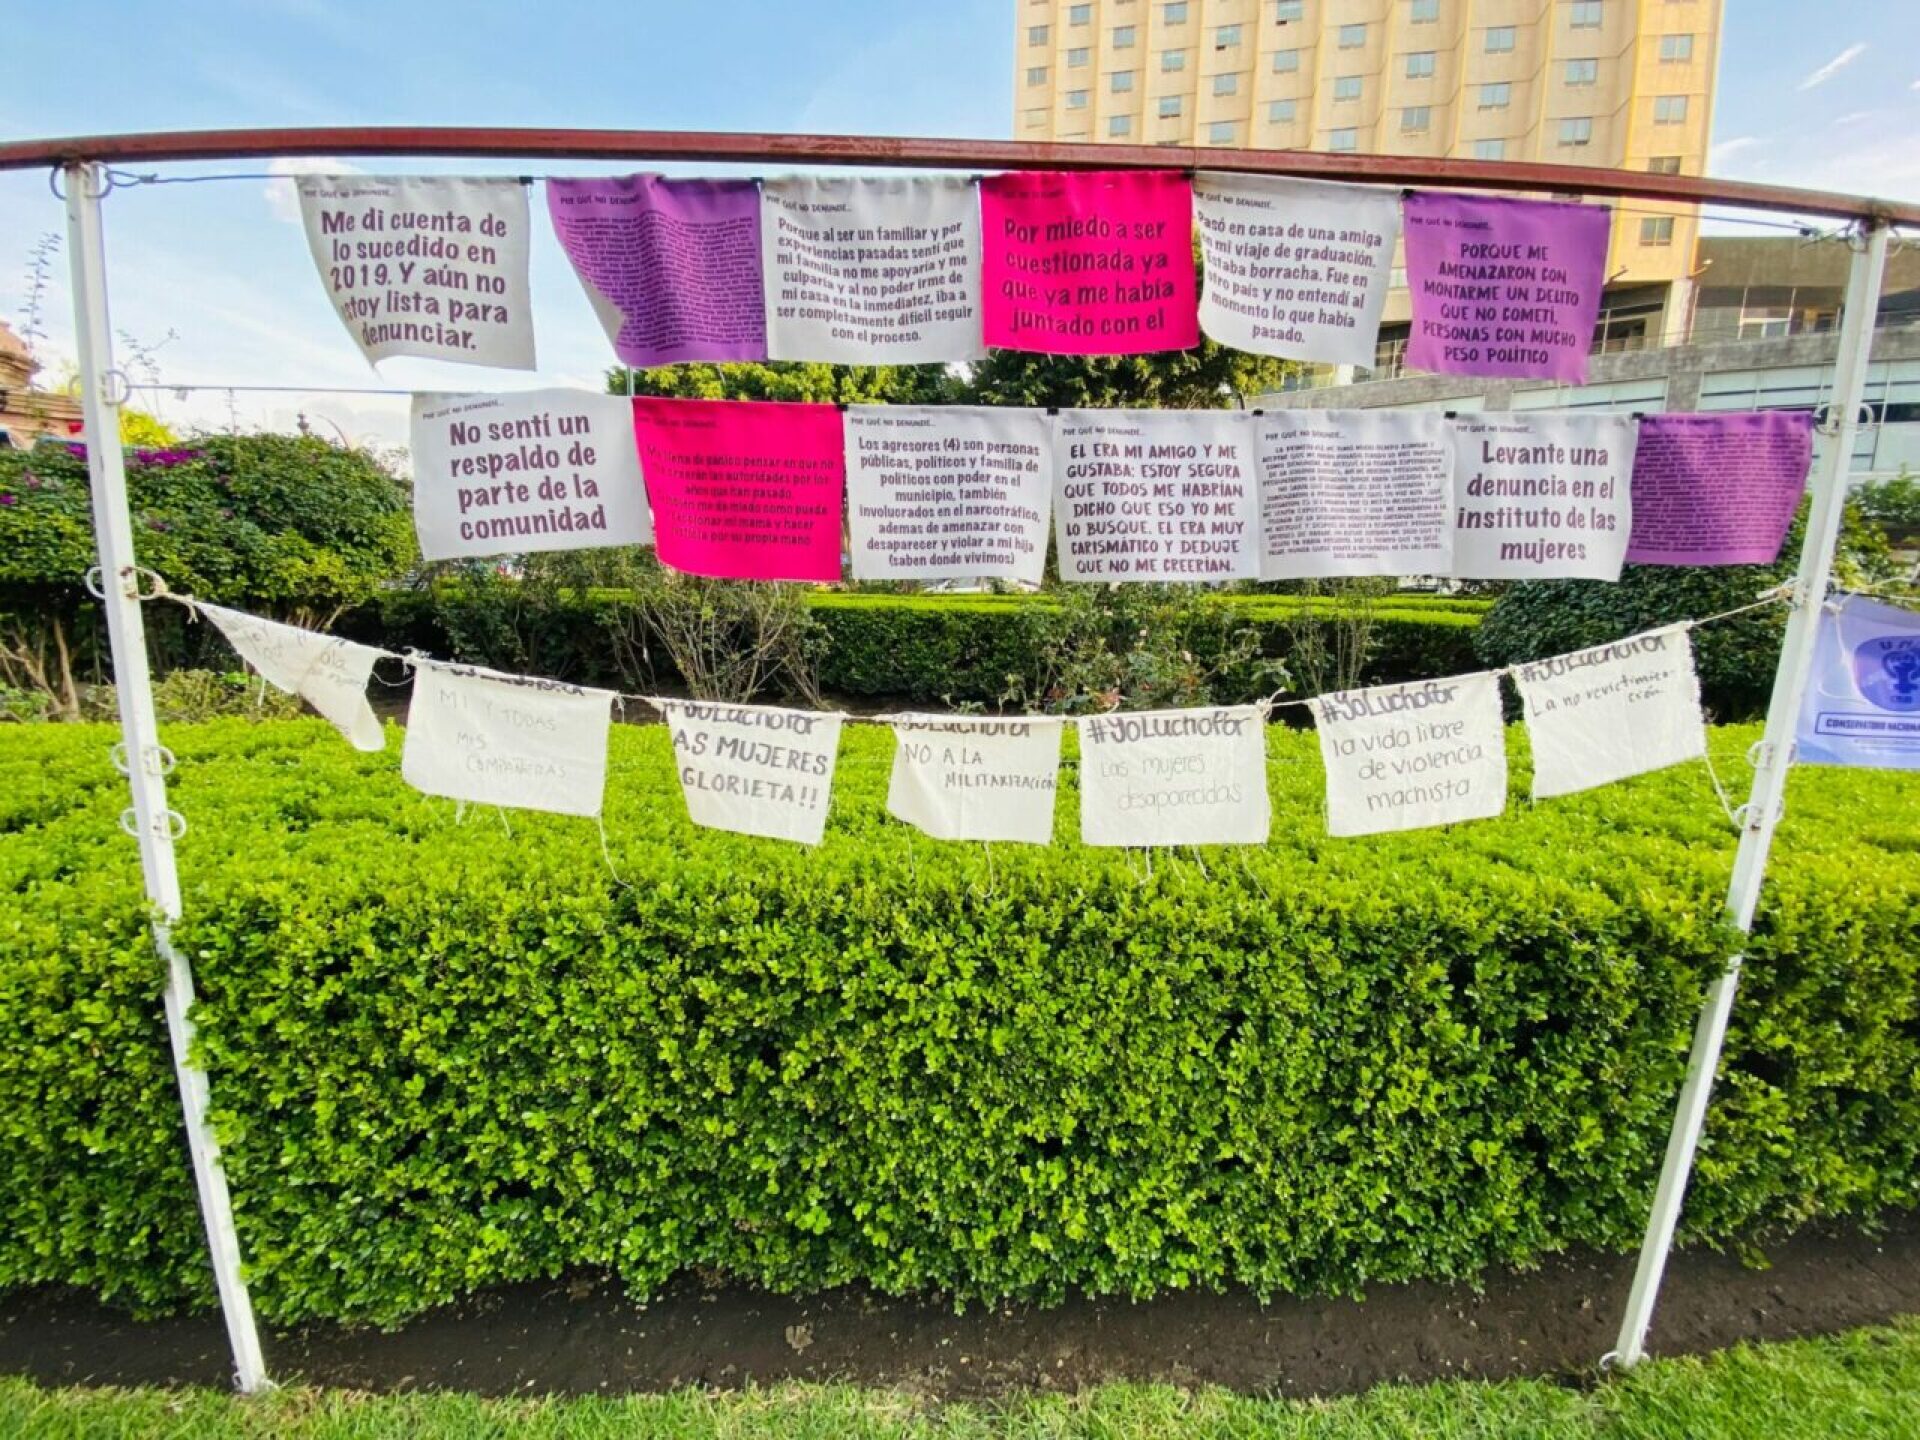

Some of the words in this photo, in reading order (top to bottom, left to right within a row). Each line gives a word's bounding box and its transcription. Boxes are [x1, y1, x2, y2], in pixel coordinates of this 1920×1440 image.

[321, 210, 355, 234] Me
[362, 207, 384, 232] di
[391, 211, 471, 233] cuenta
[480, 213, 507, 237] de
[778, 216, 819, 241] Porque
[822, 227, 834, 242] al
[837, 228, 854, 241] ser
[858, 229, 874, 241] un
[878, 227, 927, 241] familiar
[931, 229, 938, 242] y
[942, 222, 962, 239] por
[1005, 216, 1038, 243] Por
[1047, 215, 1110, 241] miedo
[1116, 224, 1127, 239] a
[1134, 222, 1165, 239] ser
[1229, 221, 1245, 235] en
[1249, 224, 1283, 237] casa
[1287, 224, 1304, 238] de
[1309, 228, 1335, 240] una
[1340, 230, 1382, 247] amiga
[333, 239, 350, 261] lo
[357, 234, 459, 260] sucedido
[467, 245, 496, 264] en
[1006, 249, 1133, 274] cuestionada
[1142, 253, 1167, 274] ya
[1460, 243, 1521, 259] PORQUE
[1527, 246, 1549, 261] ME
[330, 263, 392, 291] 2019.
[399, 262, 415, 284] Y
[424, 264, 468, 290] aún
[476, 274, 505, 294] no
[1438, 261, 1536, 281] AMENAZARON
[1541, 268, 1566, 285] CON
[1002, 280, 1037, 300] que
[1045, 289, 1070, 306] ya
[1078, 286, 1108, 304] me
[1115, 279, 1174, 304] había
[1424, 280, 1500, 300] MONTARME
[1507, 287, 1528, 301] UN
[1536, 288, 1579, 306] DELITO
[343, 296, 379, 321] stoy
[387, 290, 439, 315] lista
[448, 299, 508, 324] para
[1440, 304, 1469, 321] QUE
[1475, 307, 1496, 321] NO
[1010, 307, 1094, 335] juntado
[1101, 316, 1139, 334] con
[1146, 308, 1164, 330] el
[1252, 324, 1304, 343] pasado.
[1423, 321, 1489, 342] PERSONAS
[1496, 328, 1524, 343] CON
[1530, 330, 1575, 347] MUCHO
[362, 322, 476, 349] denunciar.
[1444, 346, 1479, 361] PESO
[1487, 345, 1548, 364] POLÍTICO
[450, 421, 480, 446] No
[489, 413, 551, 441] sentí
[558, 415, 590, 435] un
[450, 444, 559, 478] respaldo
[568, 441, 596, 467] de
[859, 437, 878, 450] Los
[882, 440, 940, 453] agresores
[943, 438, 960, 453] (4)
[963, 441, 984, 451] son
[987, 443, 1039, 456] personas
[1070, 444, 1086, 459] EL
[1093, 444, 1119, 457] ERA
[1125, 445, 1143, 458] MI
[1149, 446, 1196, 458] AMIGO
[1203, 444, 1212, 458] Y
[1218, 446, 1237, 458] ME
[1482, 440, 1565, 465] Levante
[1570, 448, 1608, 465] una
[1141, 465, 1180, 478] ESTOY
[1188, 465, 1240, 478] SEGURA
[458, 481, 529, 514] parte
[538, 475, 567, 501] de
[573, 473, 599, 499] la
[1064, 483, 1095, 498] QUE
[1103, 482, 1148, 496] TODOS
[1153, 484, 1174, 496] ME
[1182, 481, 1243, 497] HABRÍAN
[1467, 473, 1567, 497] denuncia
[1572, 481, 1593, 498] en
[1600, 476, 1614, 499] el
[461, 503, 607, 540] comunidad
[1073, 502, 1115, 517] DICHO
[1121, 501, 1151, 515] QUE
[1158, 503, 1184, 516] ESO
[1191, 503, 1208, 515] YO
[1214, 503, 1235, 516] ME
[1457, 507, 1561, 528] instituto
[1567, 507, 1585, 529] de
[1591, 507, 1616, 531] las
[1066, 524, 1080, 536] LO
[1158, 522, 1173, 534] EL
[1180, 522, 1205, 534] ERA
[1211, 522, 1244, 534] MUY
[930, 553, 962, 565] donde
[1071, 537, 1158, 555] CARISMÁTICO
[1164, 540, 1173, 552] Y
[1180, 540, 1240, 554] DEDUJE
[1500, 538, 1586, 564] mujeres
[1077, 560, 1102, 574] QUE
[1109, 560, 1129, 572] NO
[1135, 560, 1158, 572] ME
[1164, 557, 1235, 572] CREERÍAN.
[1333, 739, 1355, 757] la
[1362, 729, 1410, 751] vida
[1417, 720, 1464, 743] libre
[716, 736, 827, 775] MUJERES
[904, 743, 932, 764] NO
[943, 747, 954, 765] A
[962, 747, 983, 764] LA
[1359, 759, 1386, 780] de
[1392, 745, 1482, 775] violencia
[1143, 754, 1205, 781] mujeres
[682, 767, 818, 809] GLORIETA!!
[1367, 779, 1470, 810] machista
